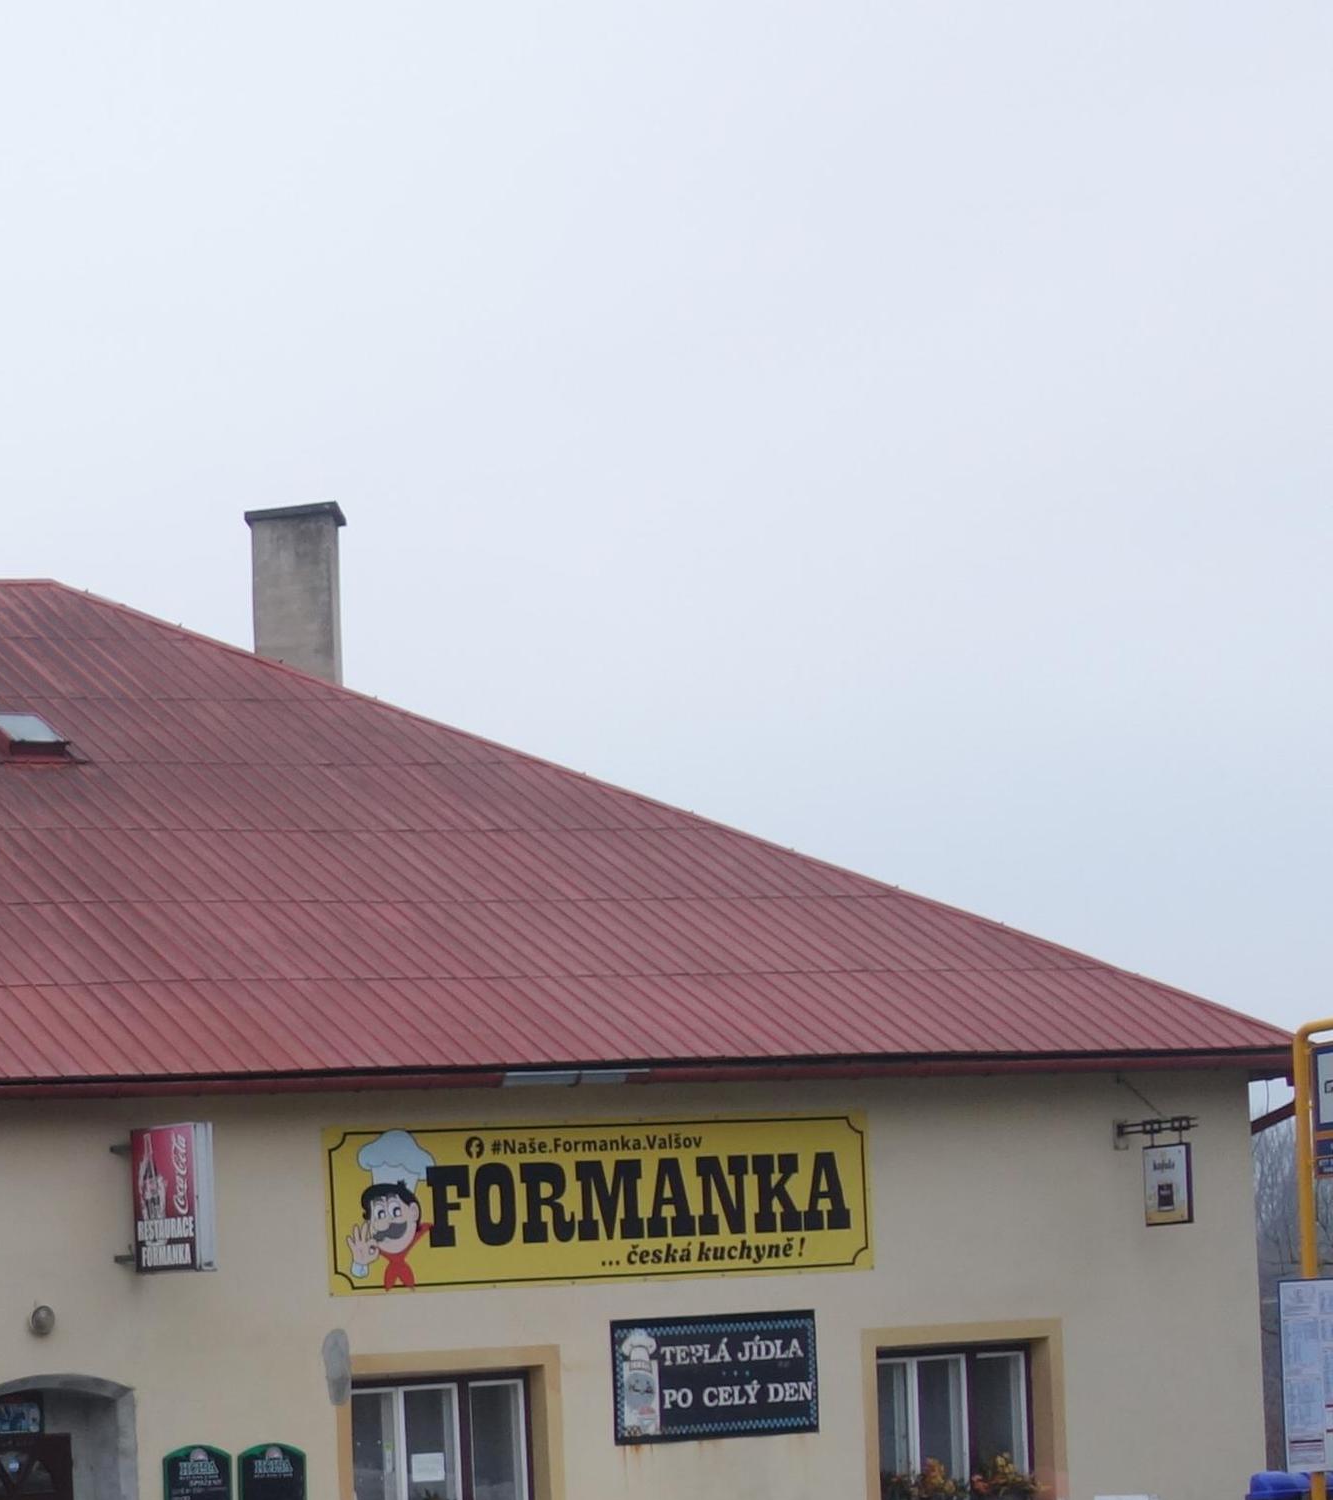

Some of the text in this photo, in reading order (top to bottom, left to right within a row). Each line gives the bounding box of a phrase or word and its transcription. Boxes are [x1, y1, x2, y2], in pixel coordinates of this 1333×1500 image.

[491, 1133, 702, 1155] #Naše.Formanka.Valšov
[426, 1152, 851, 1248] FORMANKA
[137, 1216, 194, 1241] RESTAURACE
[142, 1243, 191, 1267] FORMANKA
[627, 1242, 691, 1266] česká
[697, 1238, 794, 1263] kuchyně
[661, 1335, 804, 1366] TEPLÁ JÍDLA
[663, 1380, 813, 1409] PO CELÝ DEN
